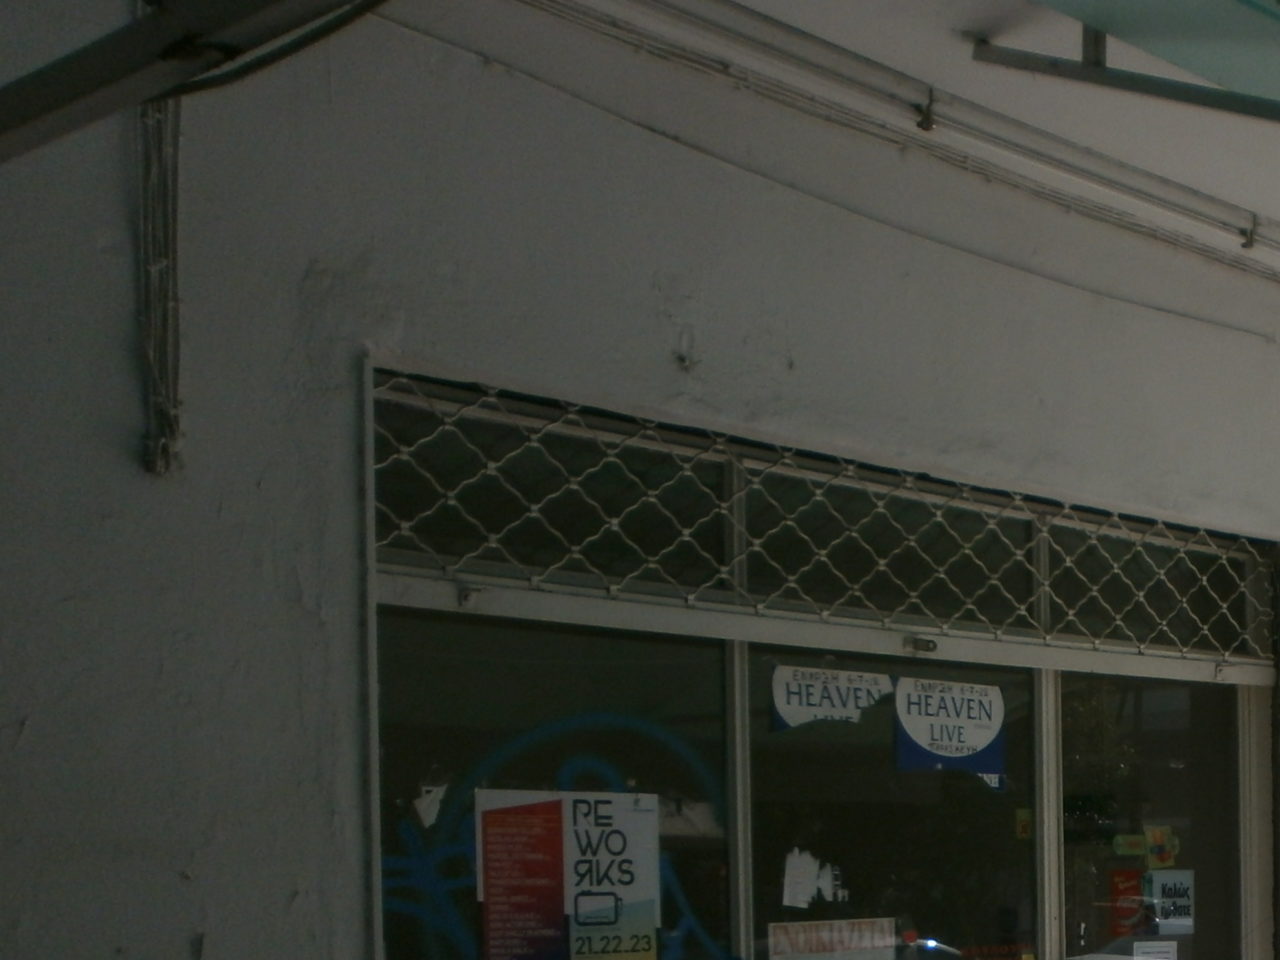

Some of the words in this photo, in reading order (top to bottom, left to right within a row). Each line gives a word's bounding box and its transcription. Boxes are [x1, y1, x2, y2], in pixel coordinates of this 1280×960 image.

[906, 692, 993, 722] HEAVEN
[929, 723, 967, 744] LIVE
[572, 799, 614, 828] RE
[574, 829, 628, 857] WO
